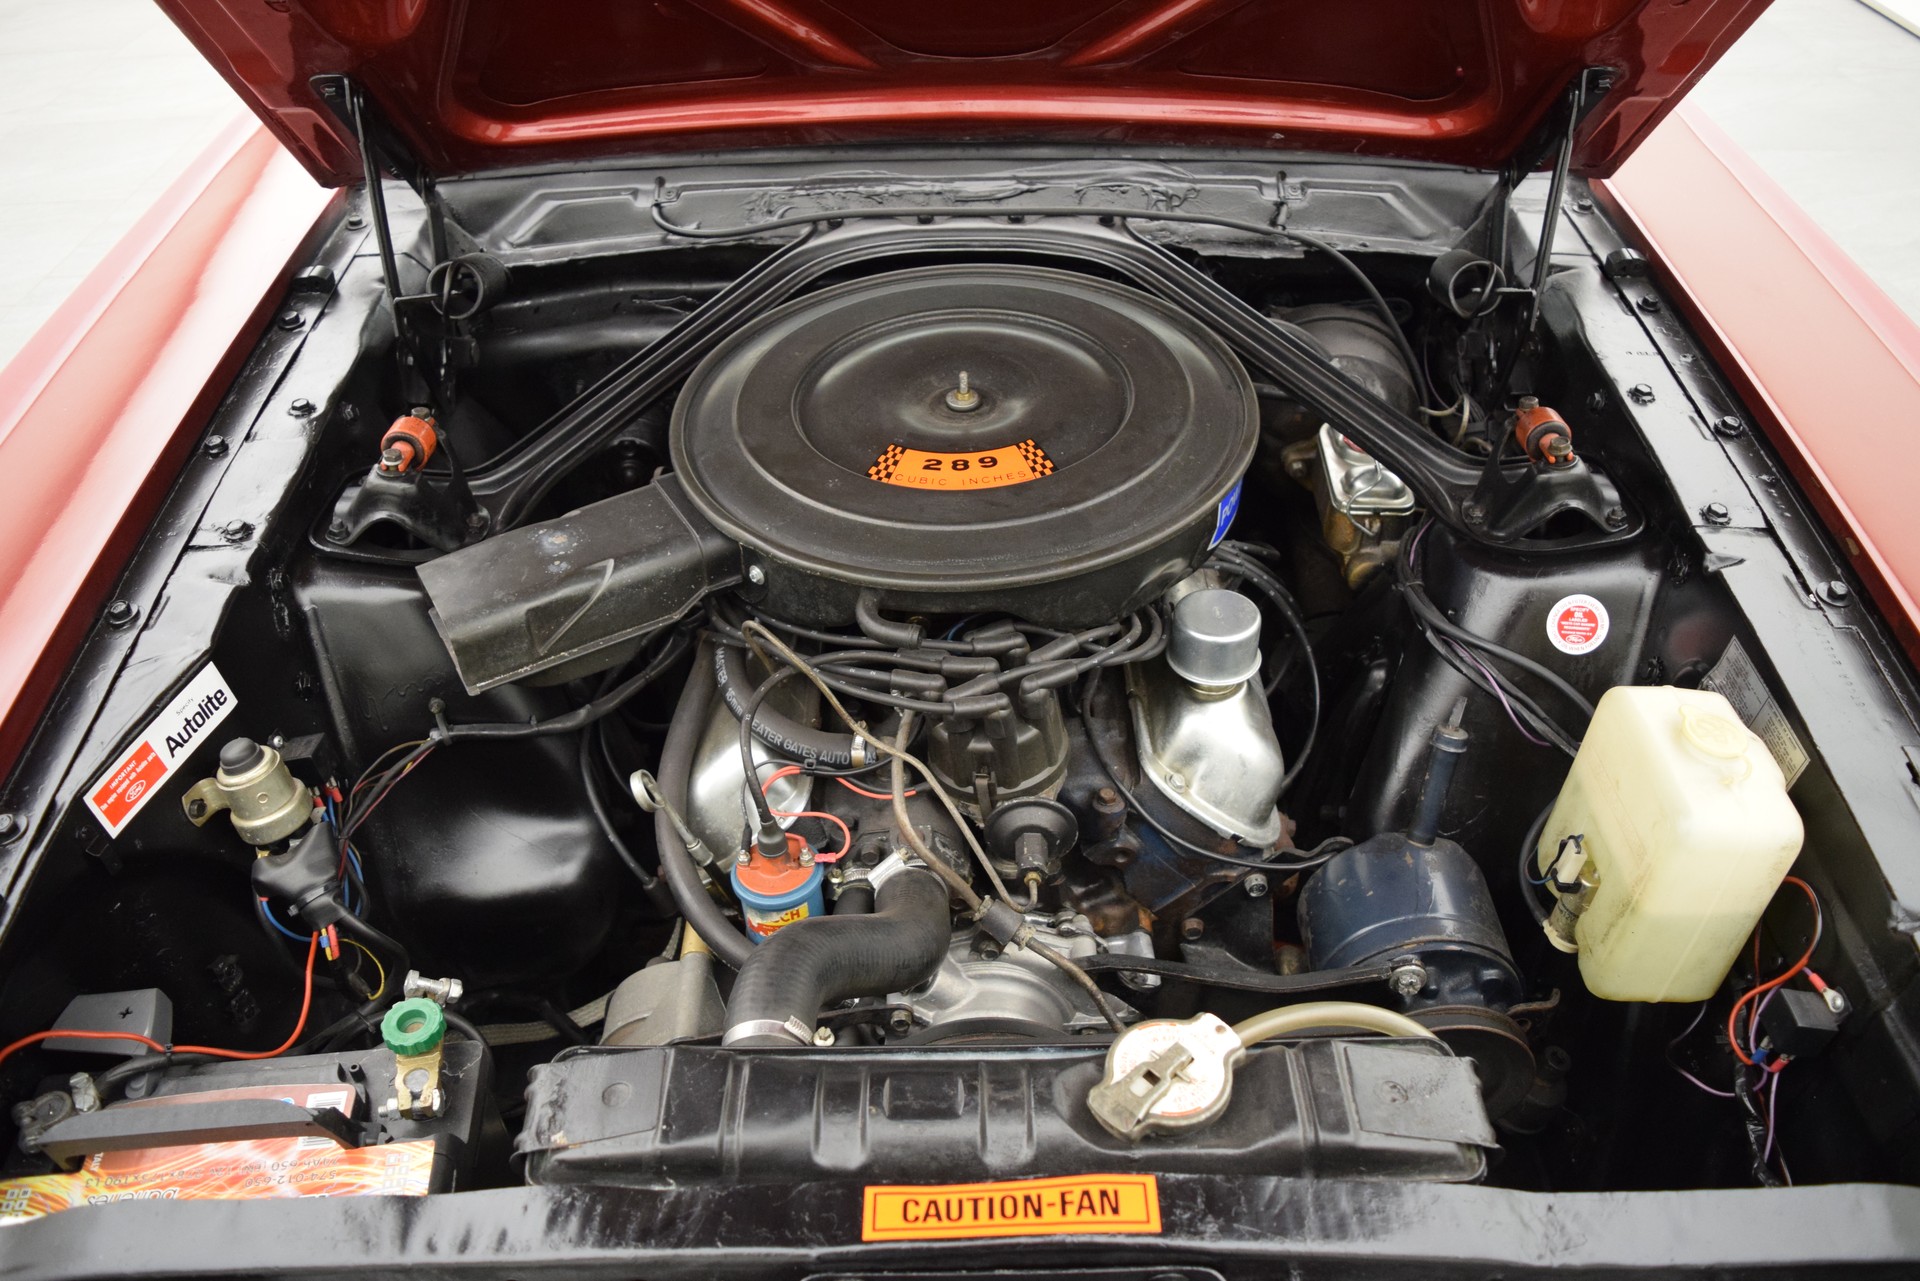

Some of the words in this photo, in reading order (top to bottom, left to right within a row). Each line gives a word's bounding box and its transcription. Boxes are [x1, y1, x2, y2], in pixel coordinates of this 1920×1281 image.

[922, 456, 998, 472] 289
[895, 473, 947, 486] CUBIC
[962, 470, 1027, 486] INCHES
[175, 697, 194, 716] Specify
[165, 688, 228, 759] Autolite
[725, 687, 743, 716] 16mm
[751, 718, 782, 747] EATER
[783, 738, 817, 760] GATES
[819, 750, 850, 765] AUTO
[109, 760, 137, 790] IMPORTANT
[129, 771, 137, 782] with
[244, 1170, 337, 1188] 574-012-650
[902, 1188, 1120, 1223] CAUTION-FAN
